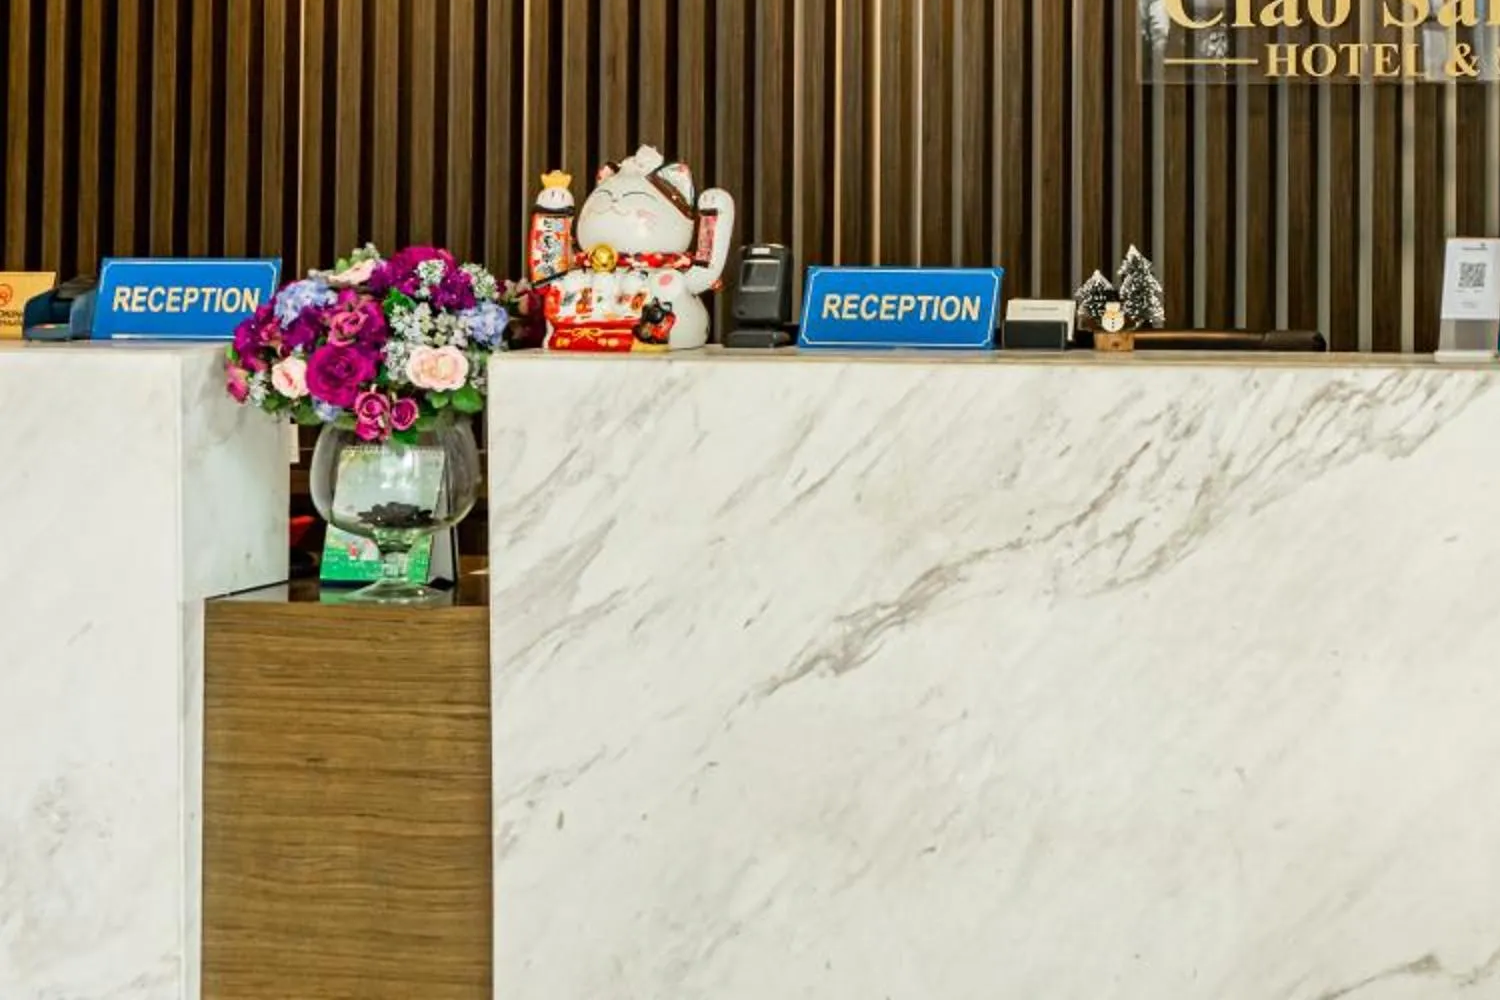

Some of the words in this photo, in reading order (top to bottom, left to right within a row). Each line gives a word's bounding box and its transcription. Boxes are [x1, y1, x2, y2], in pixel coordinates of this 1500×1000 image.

[1264, 42, 1429, 78] HOTEL
[1444, 42, 1481, 78] &
[112, 285, 262, 313] RECEPTION
[820, 292, 981, 322] RECEPTION
